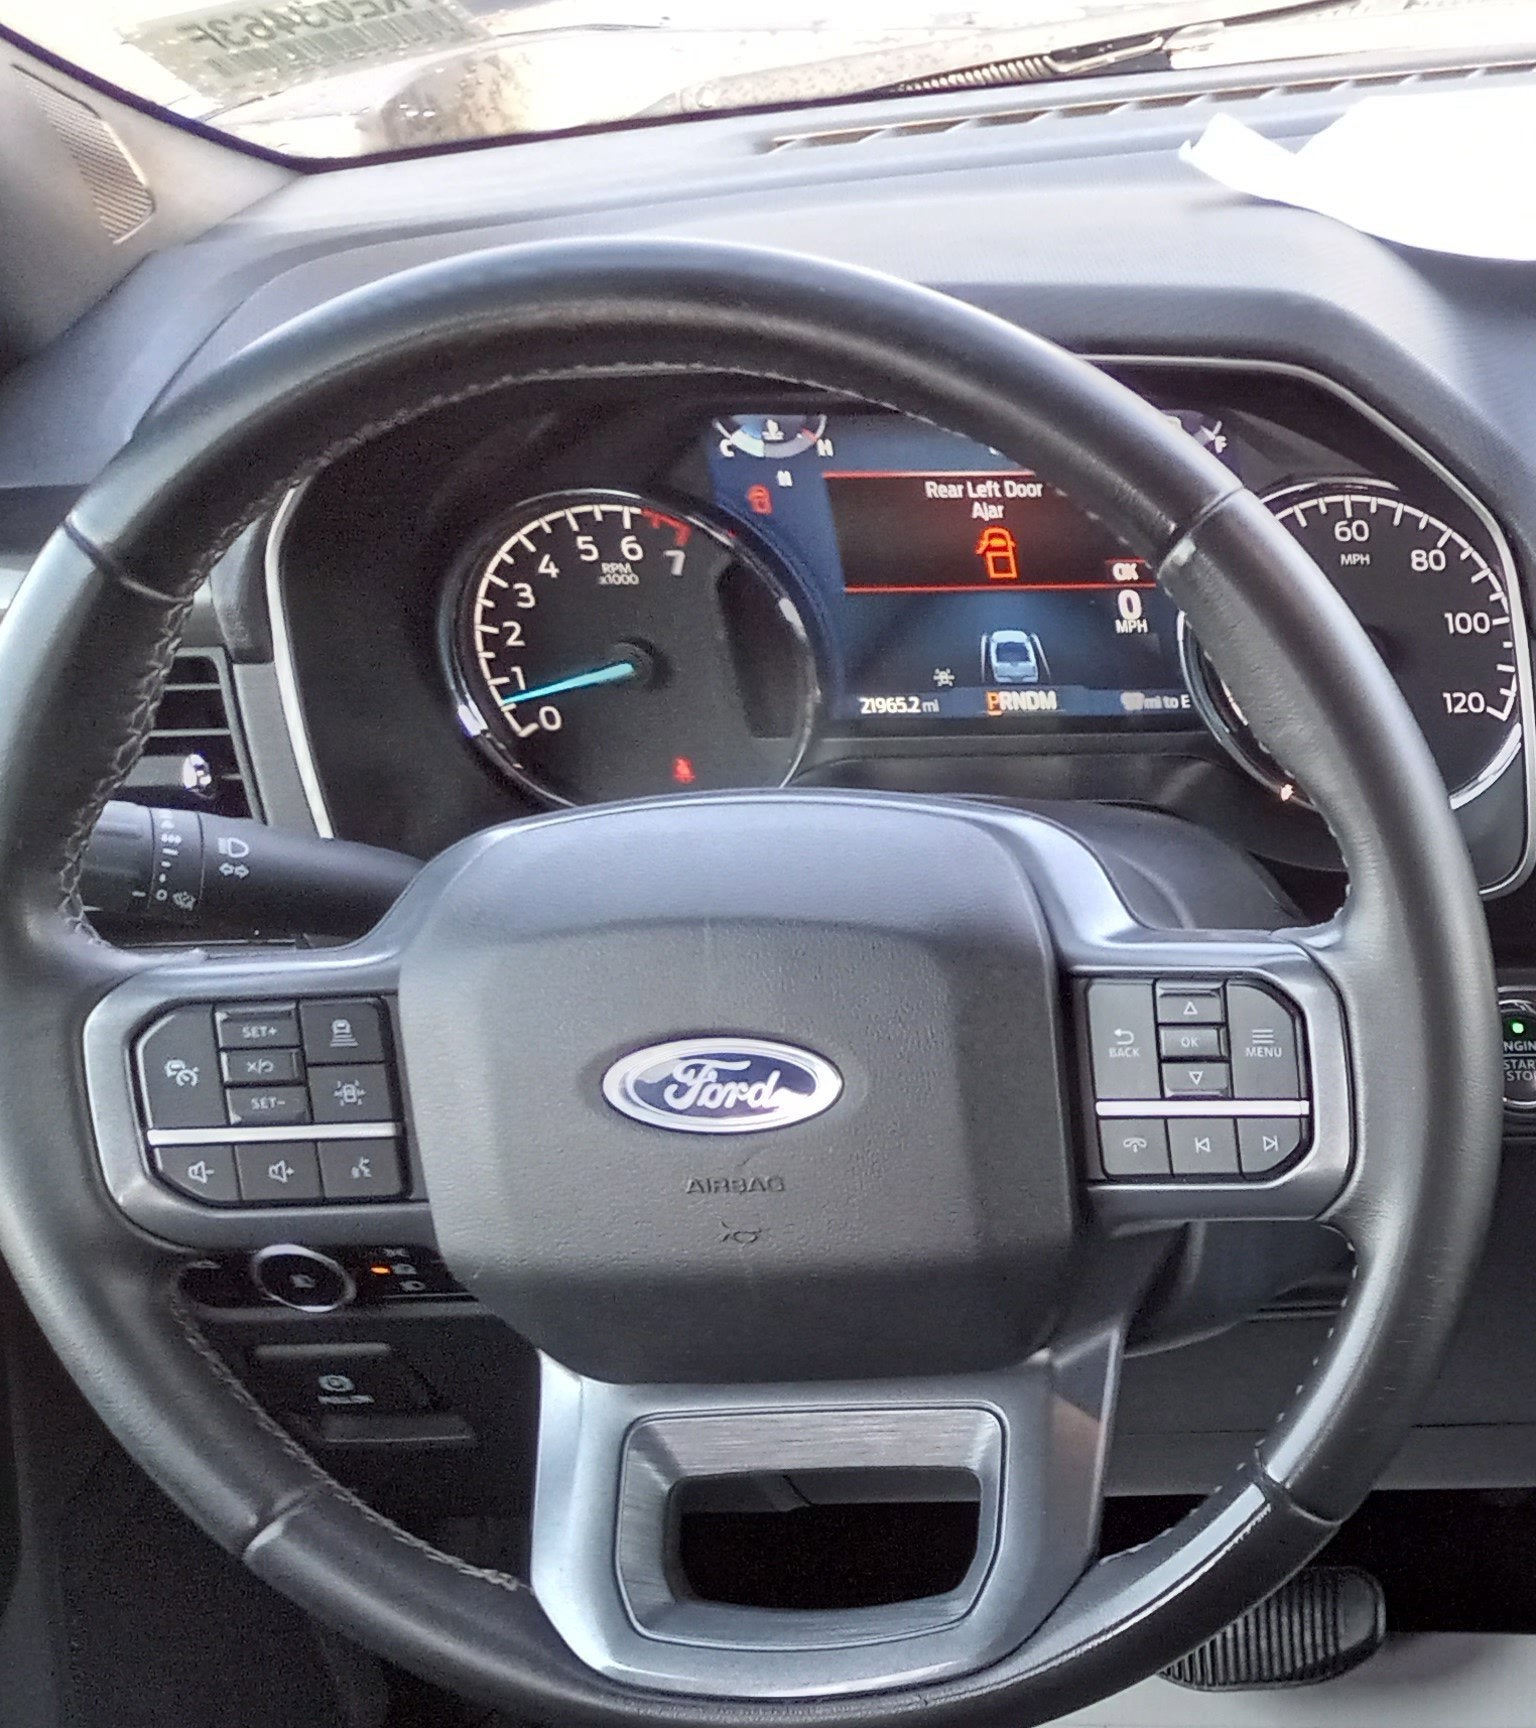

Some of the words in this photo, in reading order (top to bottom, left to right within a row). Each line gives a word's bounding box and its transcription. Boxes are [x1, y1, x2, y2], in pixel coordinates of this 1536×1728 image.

[925, 481, 964, 498] Rear
[966, 481, 1002, 498] Left
[1003, 480, 1043, 498] Door
[971, 501, 1005, 521] Ajar
[1334, 519, 1369, 543] 60
[576, 537, 598, 562] 5
[620, 537, 643, 561] 6
[1340, 552, 1371, 567] MPH
[1410, 549, 1446, 572] 80
[537, 554, 560, 577] 4
[601, 562, 632, 574] RPM
[665, 550, 685, 575] 7
[1112, 563, 1139, 581] OK
[515, 585, 536, 609] 3
[1117, 589, 1142, 620] 0
[503, 622, 525, 646] 2
[1115, 619, 1148, 633] MPH
[1444, 612, 1490, 635] 100
[510, 667, 526, 690] 1
[861, 696, 921, 714] 21965.2
[922, 699, 940, 713] mi
[1181, 694, 1191, 709] E
[1443, 692, 1485, 714] 120
[538, 706, 562, 731] 0
[1108, 1047, 1140, 1058] BACK
[1181, 1037, 1198, 1048] OK
[1246, 1047, 1282, 1058] MENU
[662, 1057, 786, 1111] Ford
